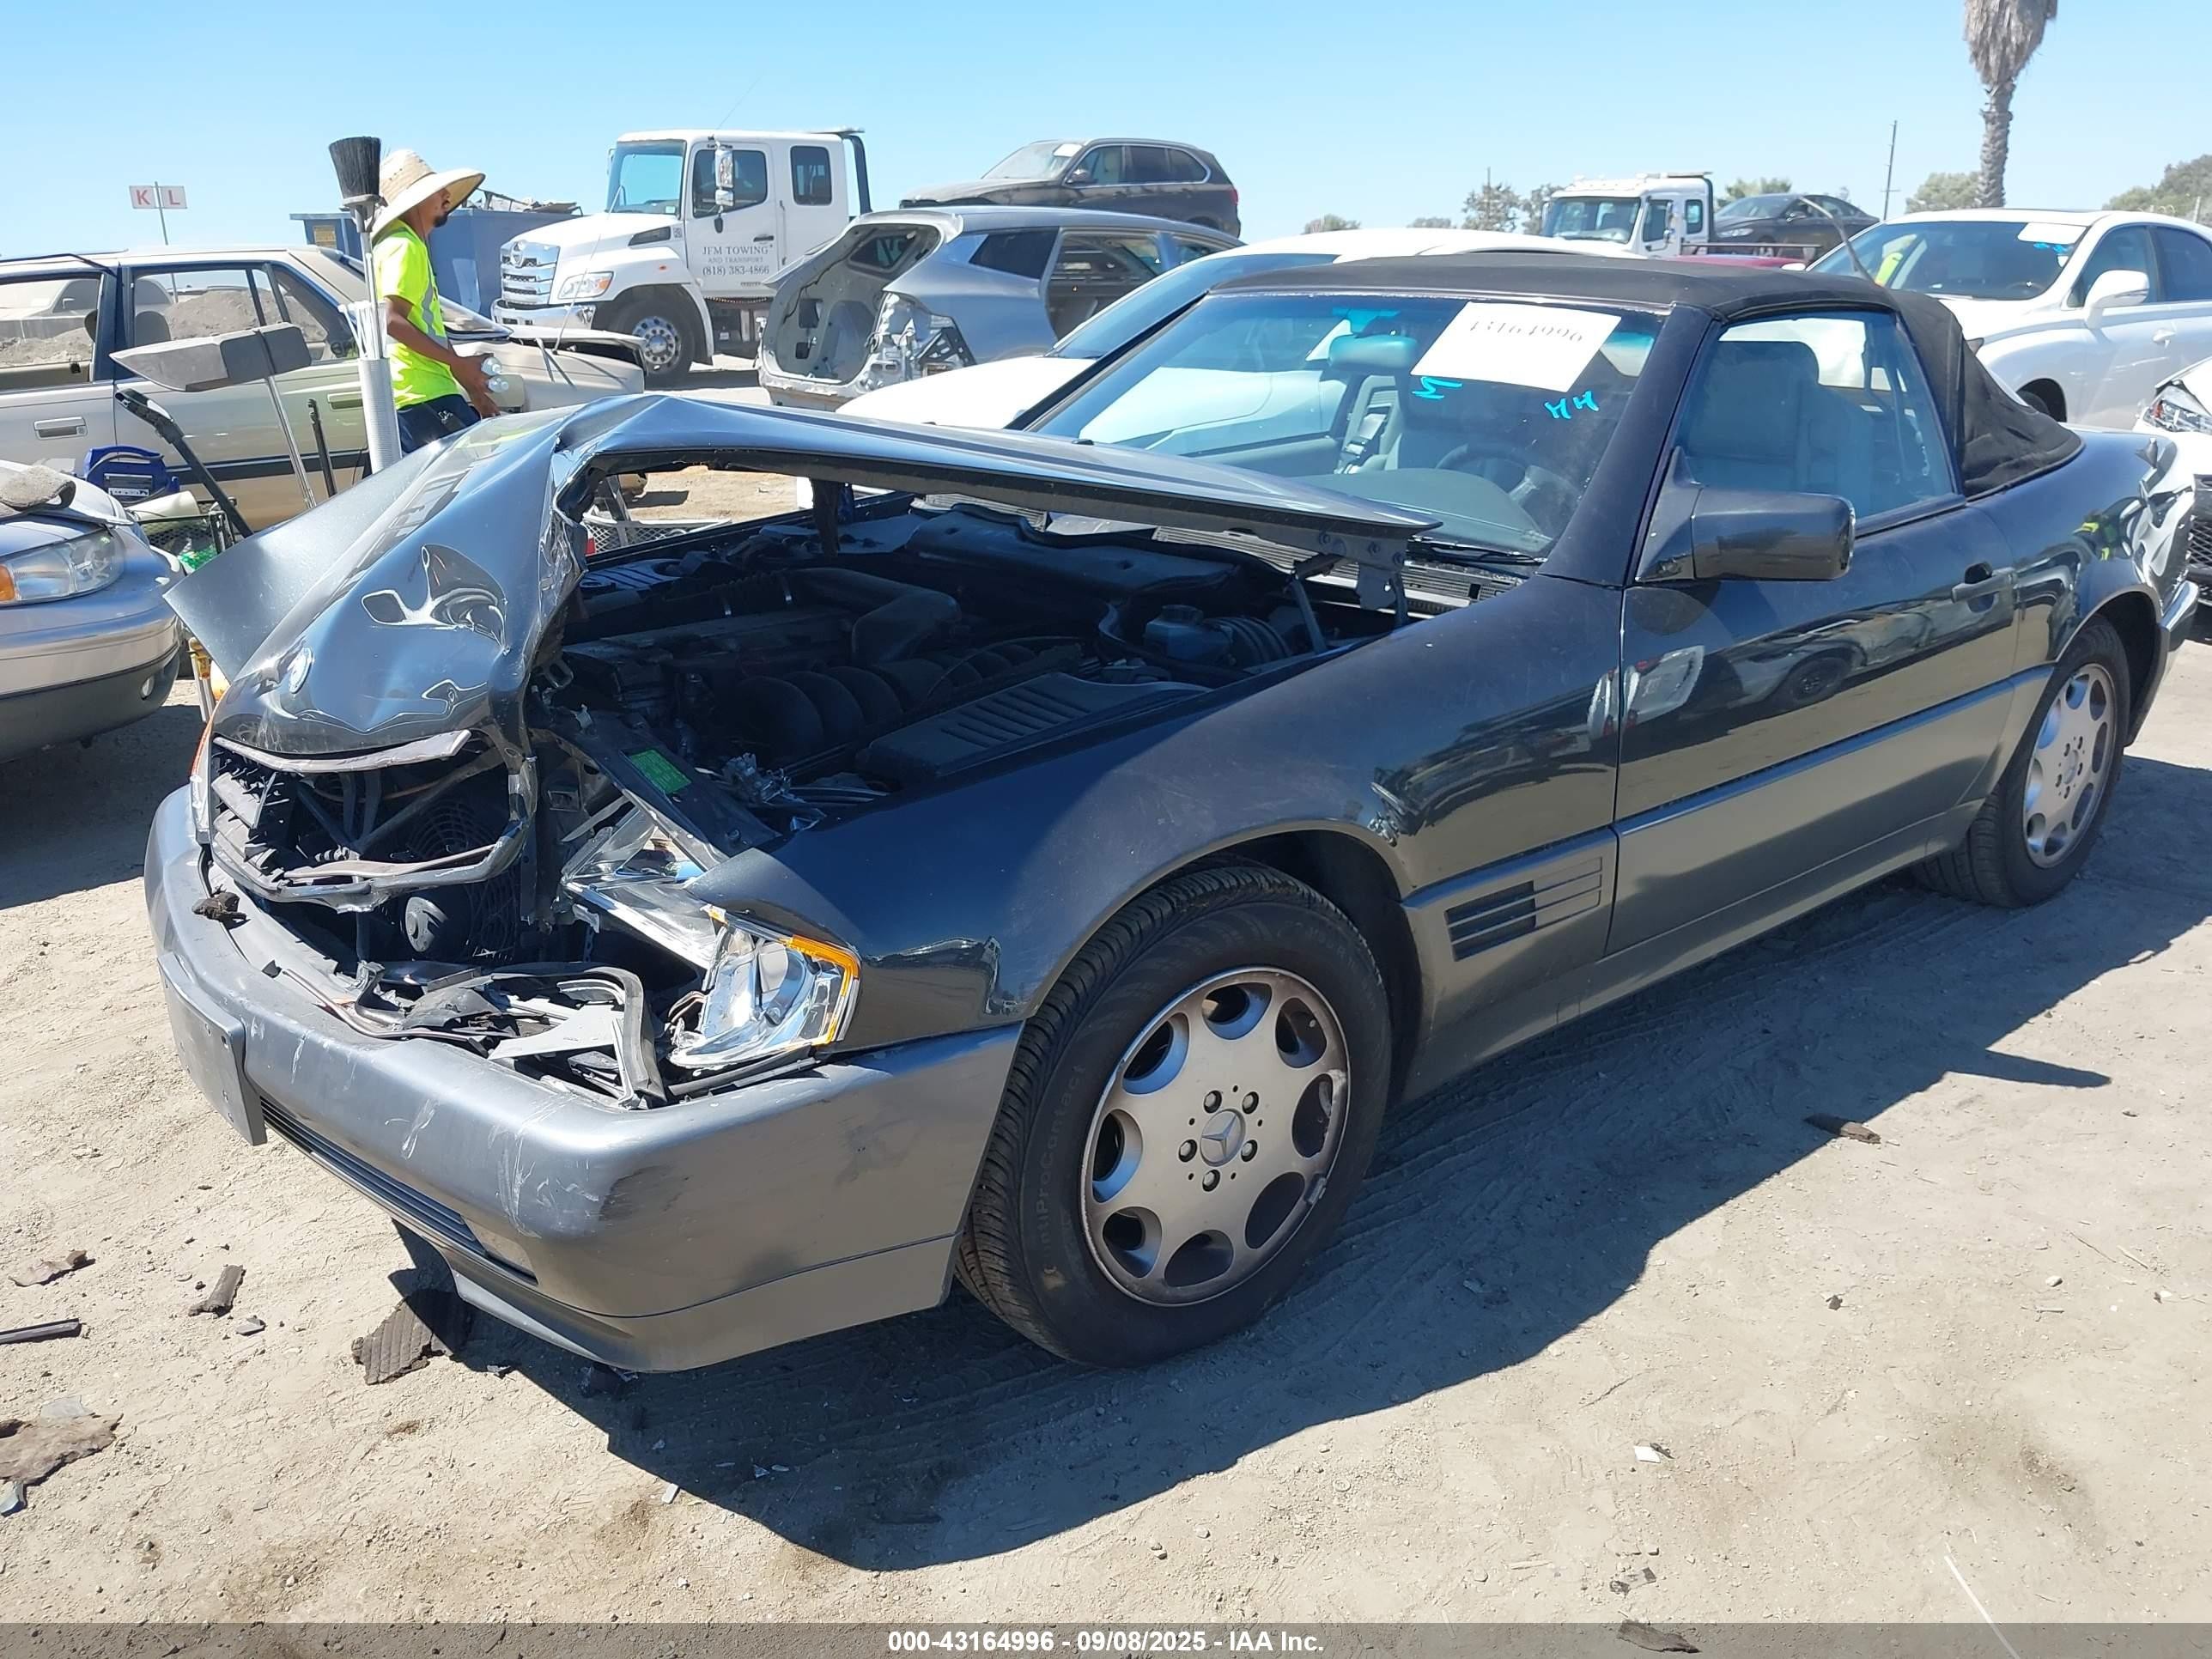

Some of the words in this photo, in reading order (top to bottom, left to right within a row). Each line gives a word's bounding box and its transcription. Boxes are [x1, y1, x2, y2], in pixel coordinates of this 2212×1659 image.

[136, 189, 151, 205] K
[167, 189, 181, 205] L
[702, 246, 723, 255] JFM
[726, 246, 769, 255] TOWING
[702, 265, 726, 276] (818)
